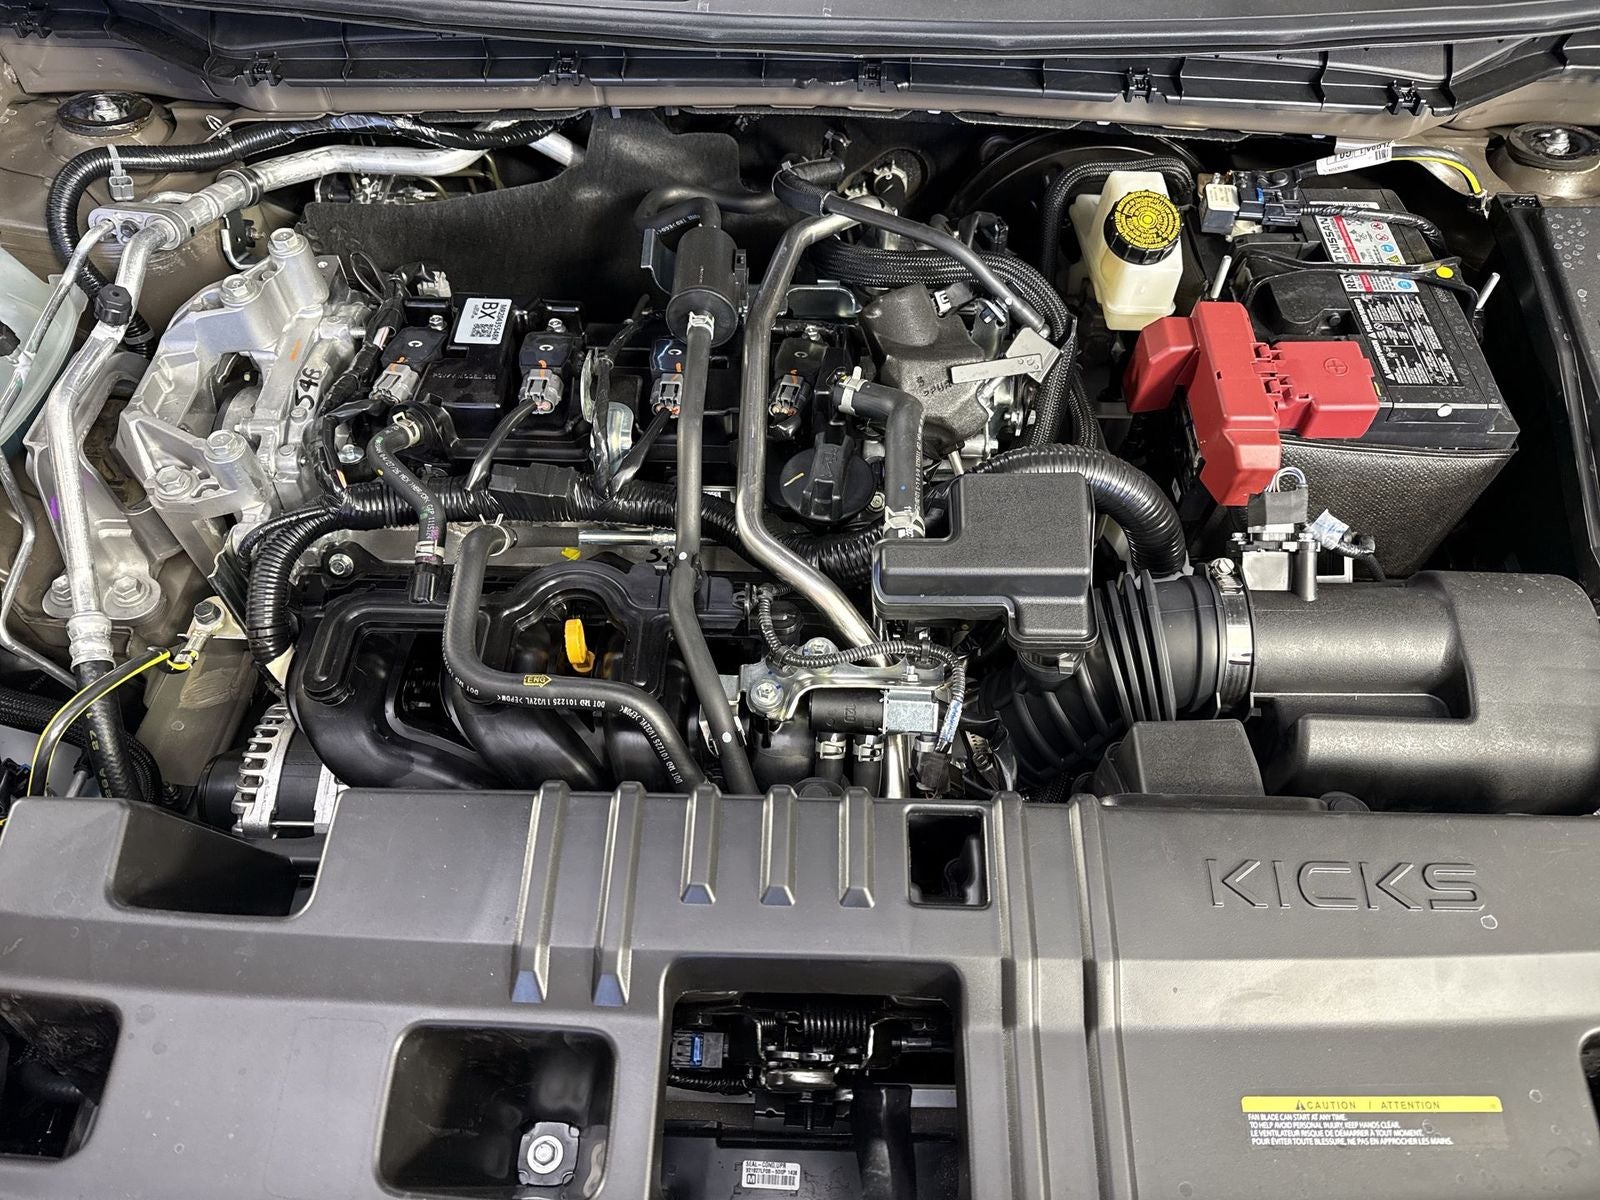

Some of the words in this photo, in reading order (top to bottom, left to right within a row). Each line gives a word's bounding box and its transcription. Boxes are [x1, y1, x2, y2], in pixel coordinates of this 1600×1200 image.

[1319, 218, 1341, 254] NISSAN
[478, 301, 499, 319] BX
[408, 340, 423, 348] C
[668, 348, 682, 356] C
[526, 676, 546, 684] ENG
[552, 698, 577, 706] 101225
[654, 739, 669, 761] 101225
[672, 771, 683, 784] DOT
[1206, 858, 1486, 912] KICKS
[1307, 1101, 1356, 1110] CAUTION
[1381, 1101, 1440, 1110] ATTENTION
[1369, 1128, 1374, 1137] À
[1270, 1137, 1292, 1145] ÉVITER
